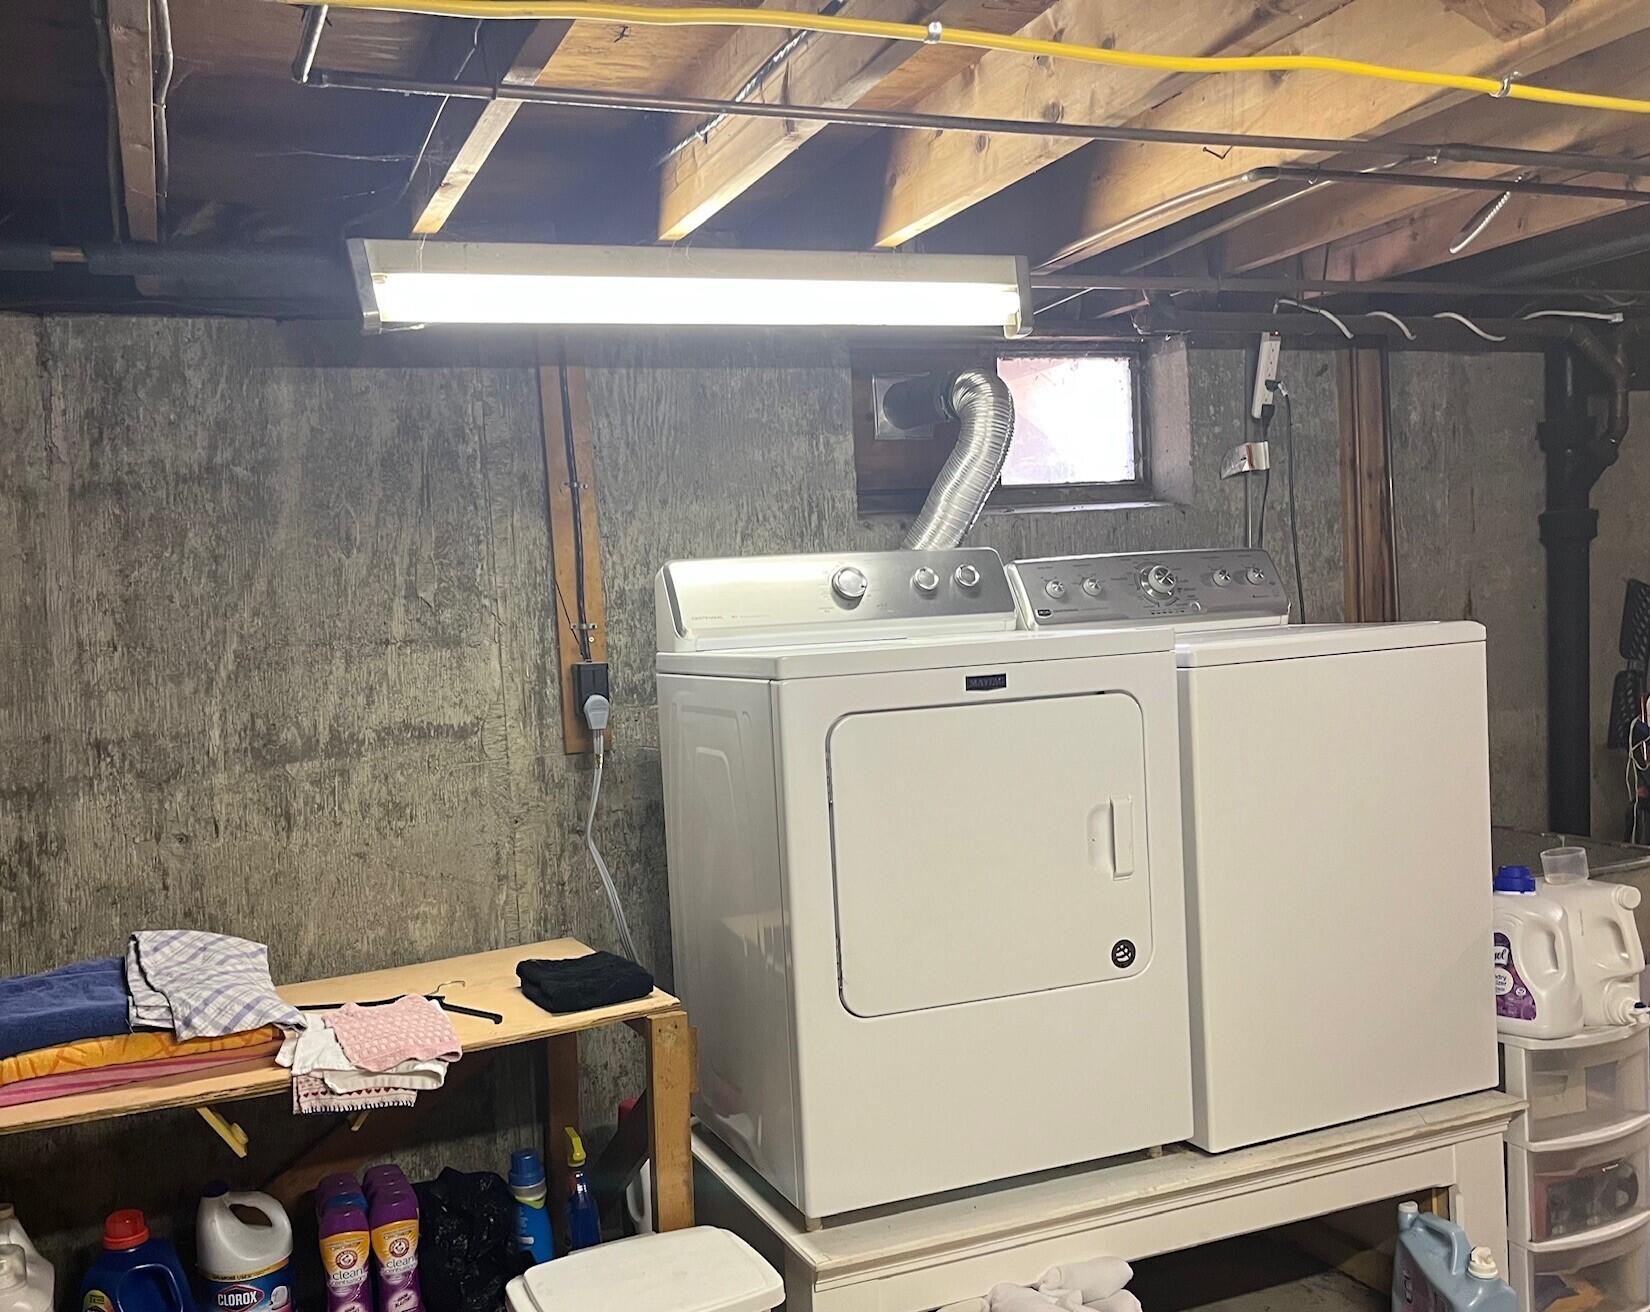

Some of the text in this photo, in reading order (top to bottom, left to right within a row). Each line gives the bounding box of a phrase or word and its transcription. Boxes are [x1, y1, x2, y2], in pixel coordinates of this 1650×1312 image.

[386, 1255, 415, 1269] clean
[332, 1268, 364, 1281] clean
[217, 1291, 258, 1306] CLOROX
